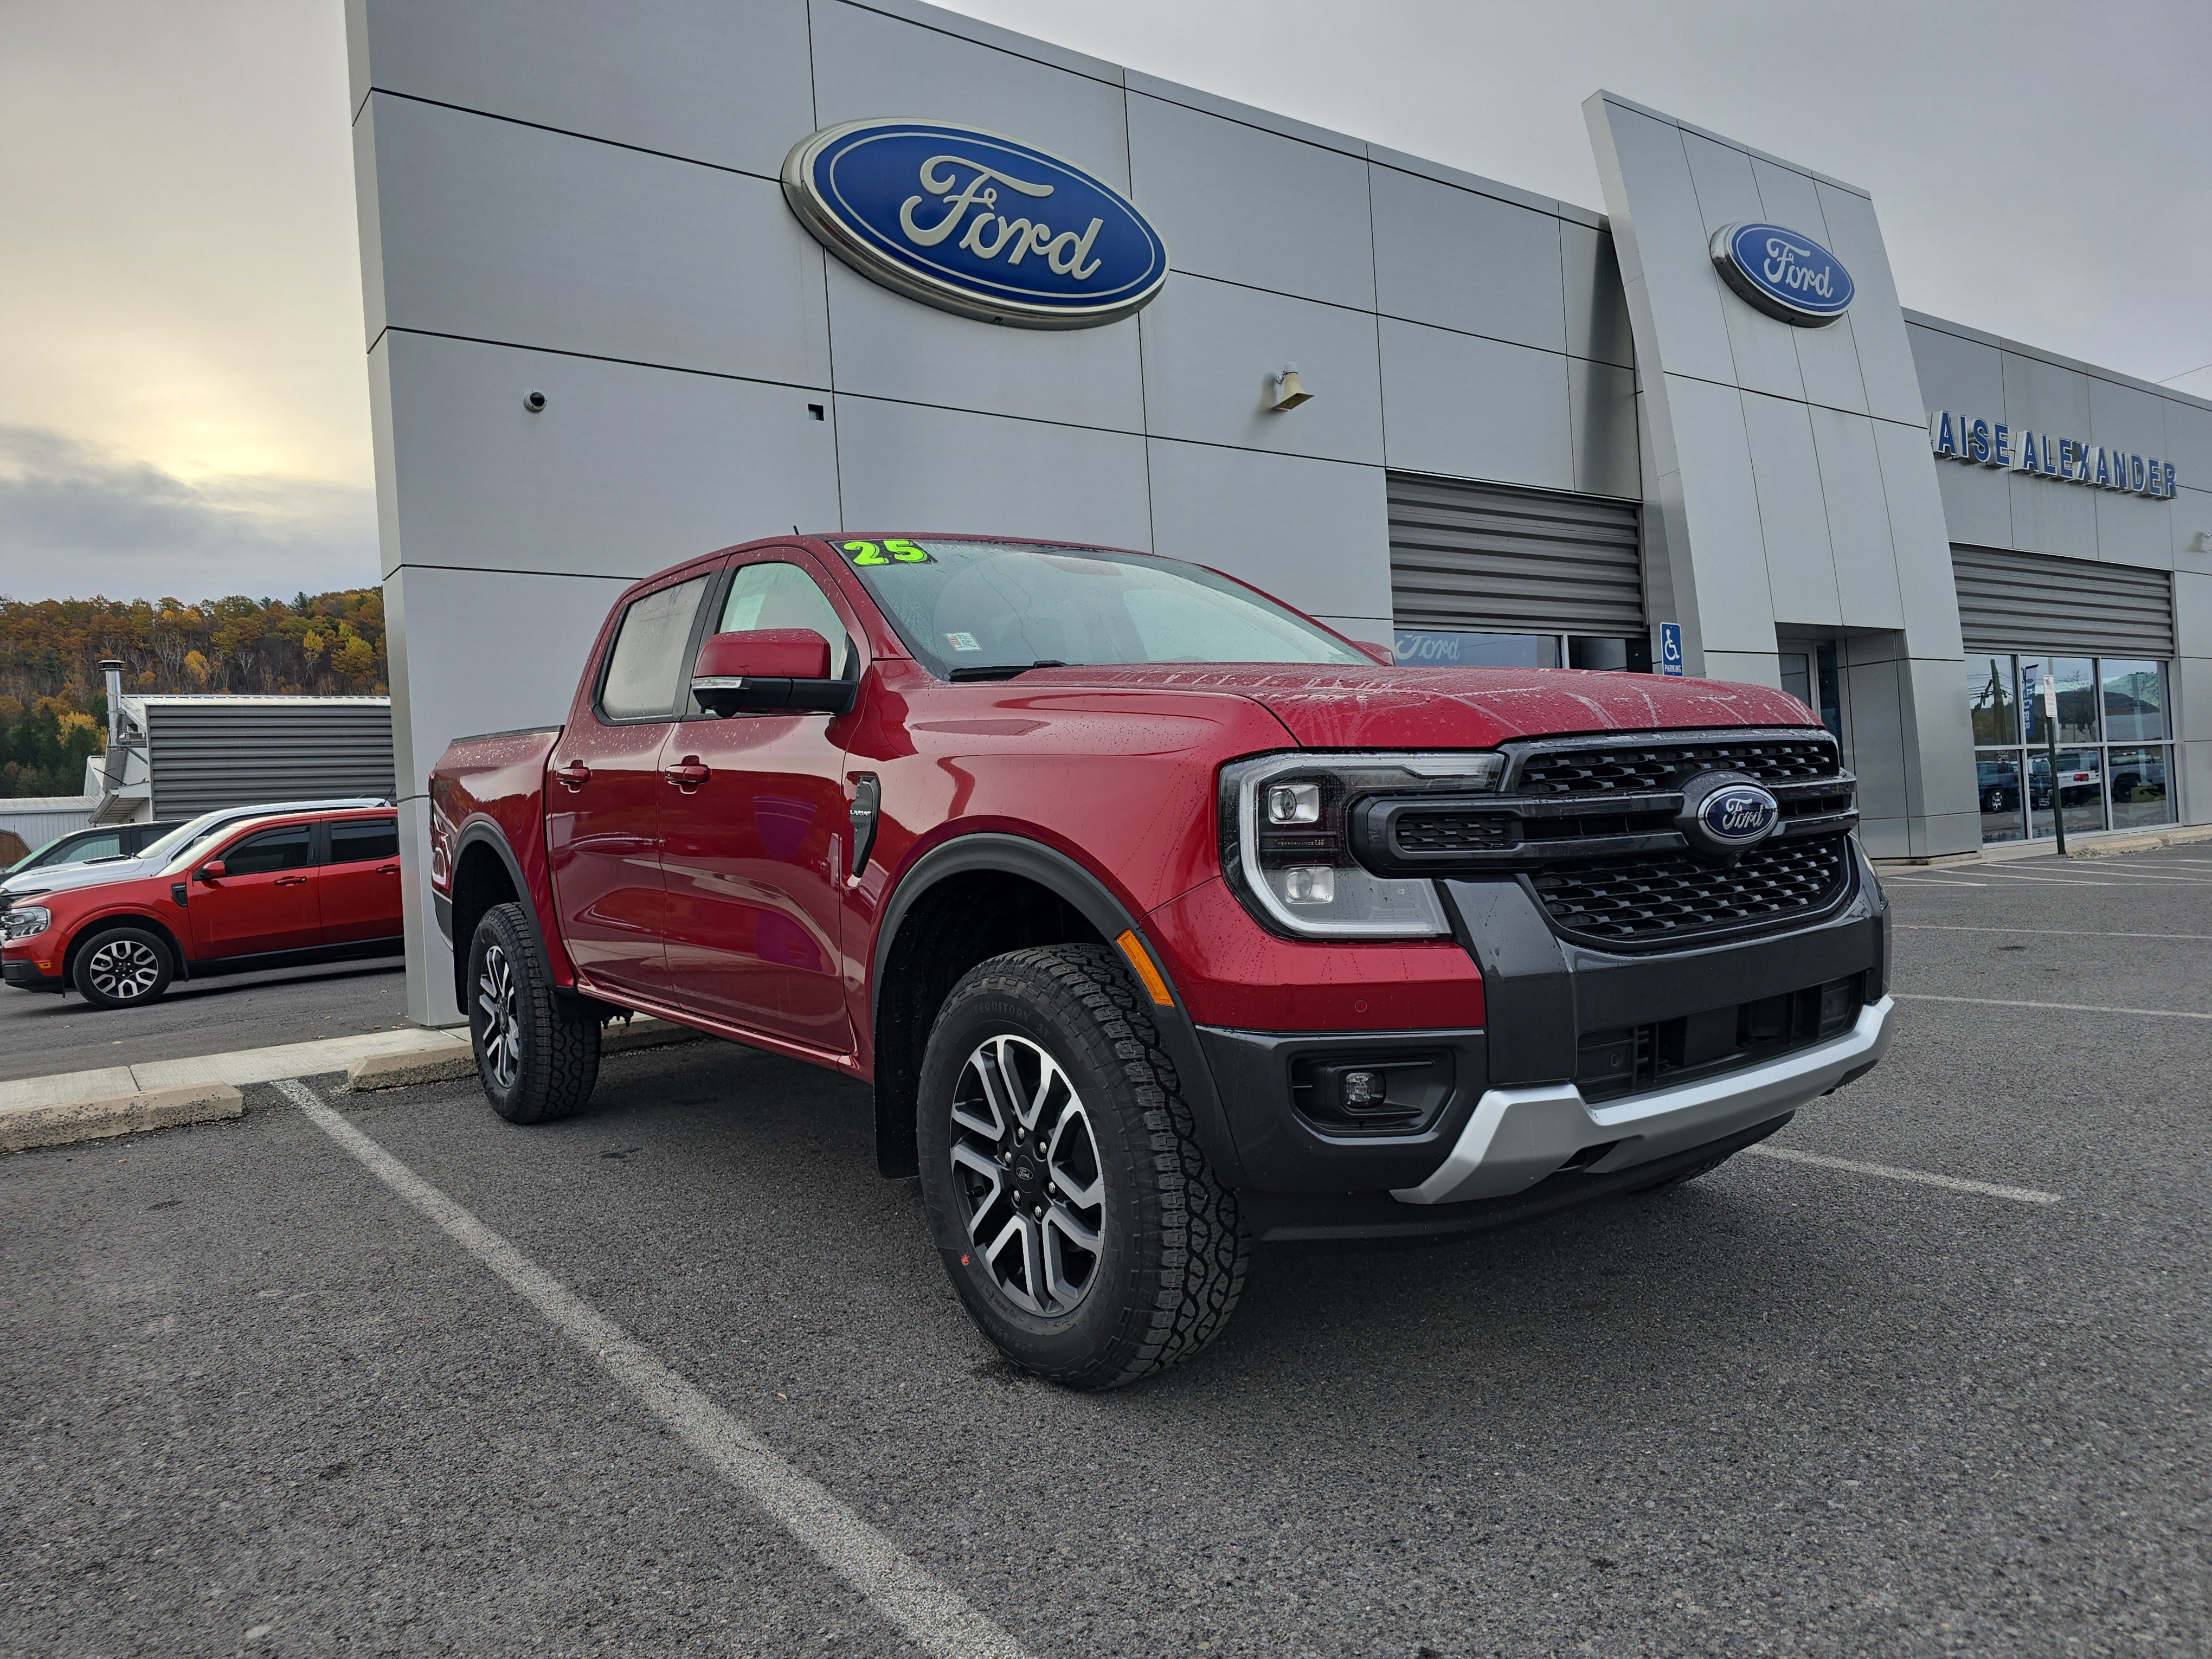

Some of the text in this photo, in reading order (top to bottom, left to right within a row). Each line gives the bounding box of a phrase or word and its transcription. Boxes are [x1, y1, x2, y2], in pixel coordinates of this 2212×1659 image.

[899, 155, 1104, 280] Ford
[1763, 238, 1834, 298] Ford
[1931, 410, 2178, 499] AISE ALEXANDER
[844, 539, 928, 566] 25
[1394, 634, 1460, 660] Ford
[1722, 798, 1764, 830] Ford
[973, 1001, 1032, 1023] TERRITORY
[1019, 1168, 1030, 1179] Ford
